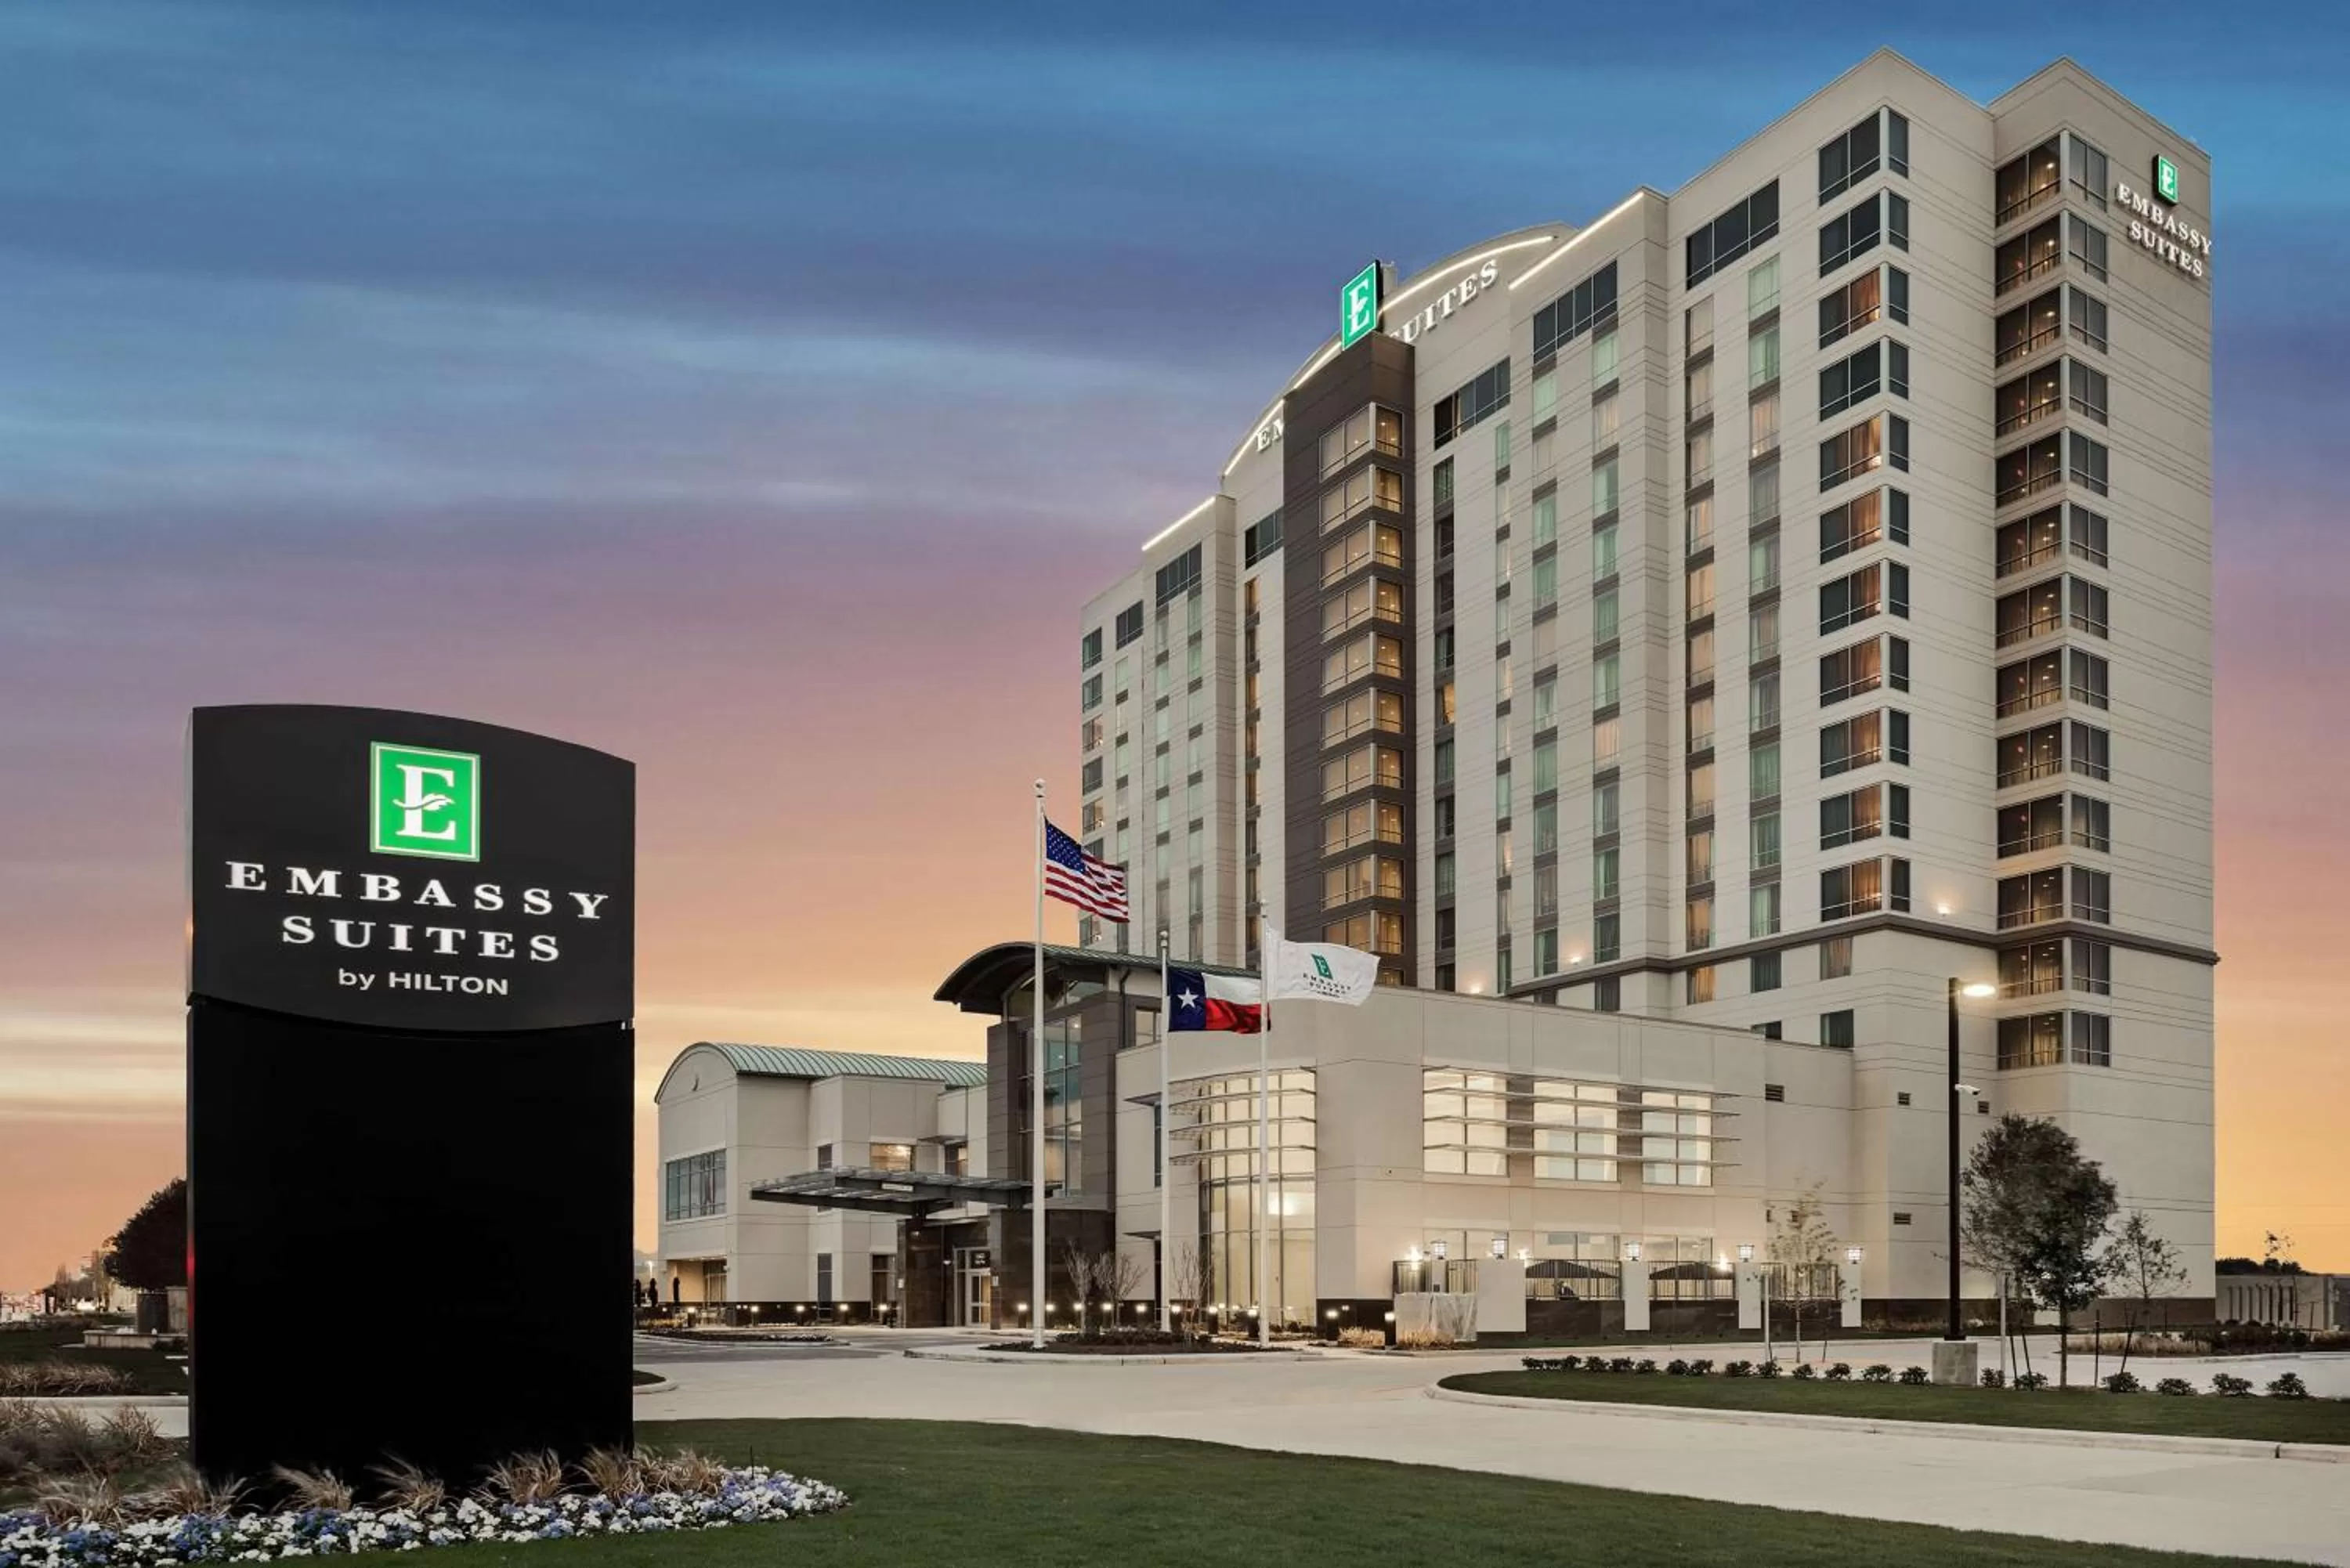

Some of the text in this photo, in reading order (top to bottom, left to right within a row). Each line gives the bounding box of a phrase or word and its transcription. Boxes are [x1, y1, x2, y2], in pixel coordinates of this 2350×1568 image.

[2161, 164, 2175, 196] E
[2117, 182, 2211, 255] EMBASSY
[2130, 220, 2203, 276] SUITES
[1348, 278, 1370, 338] E
[393, 764, 456, 840] E
[226, 862, 609, 919] EMBASSY
[282, 916, 559, 962] SUITES
[338, 969, 508, 995] by HILTON
